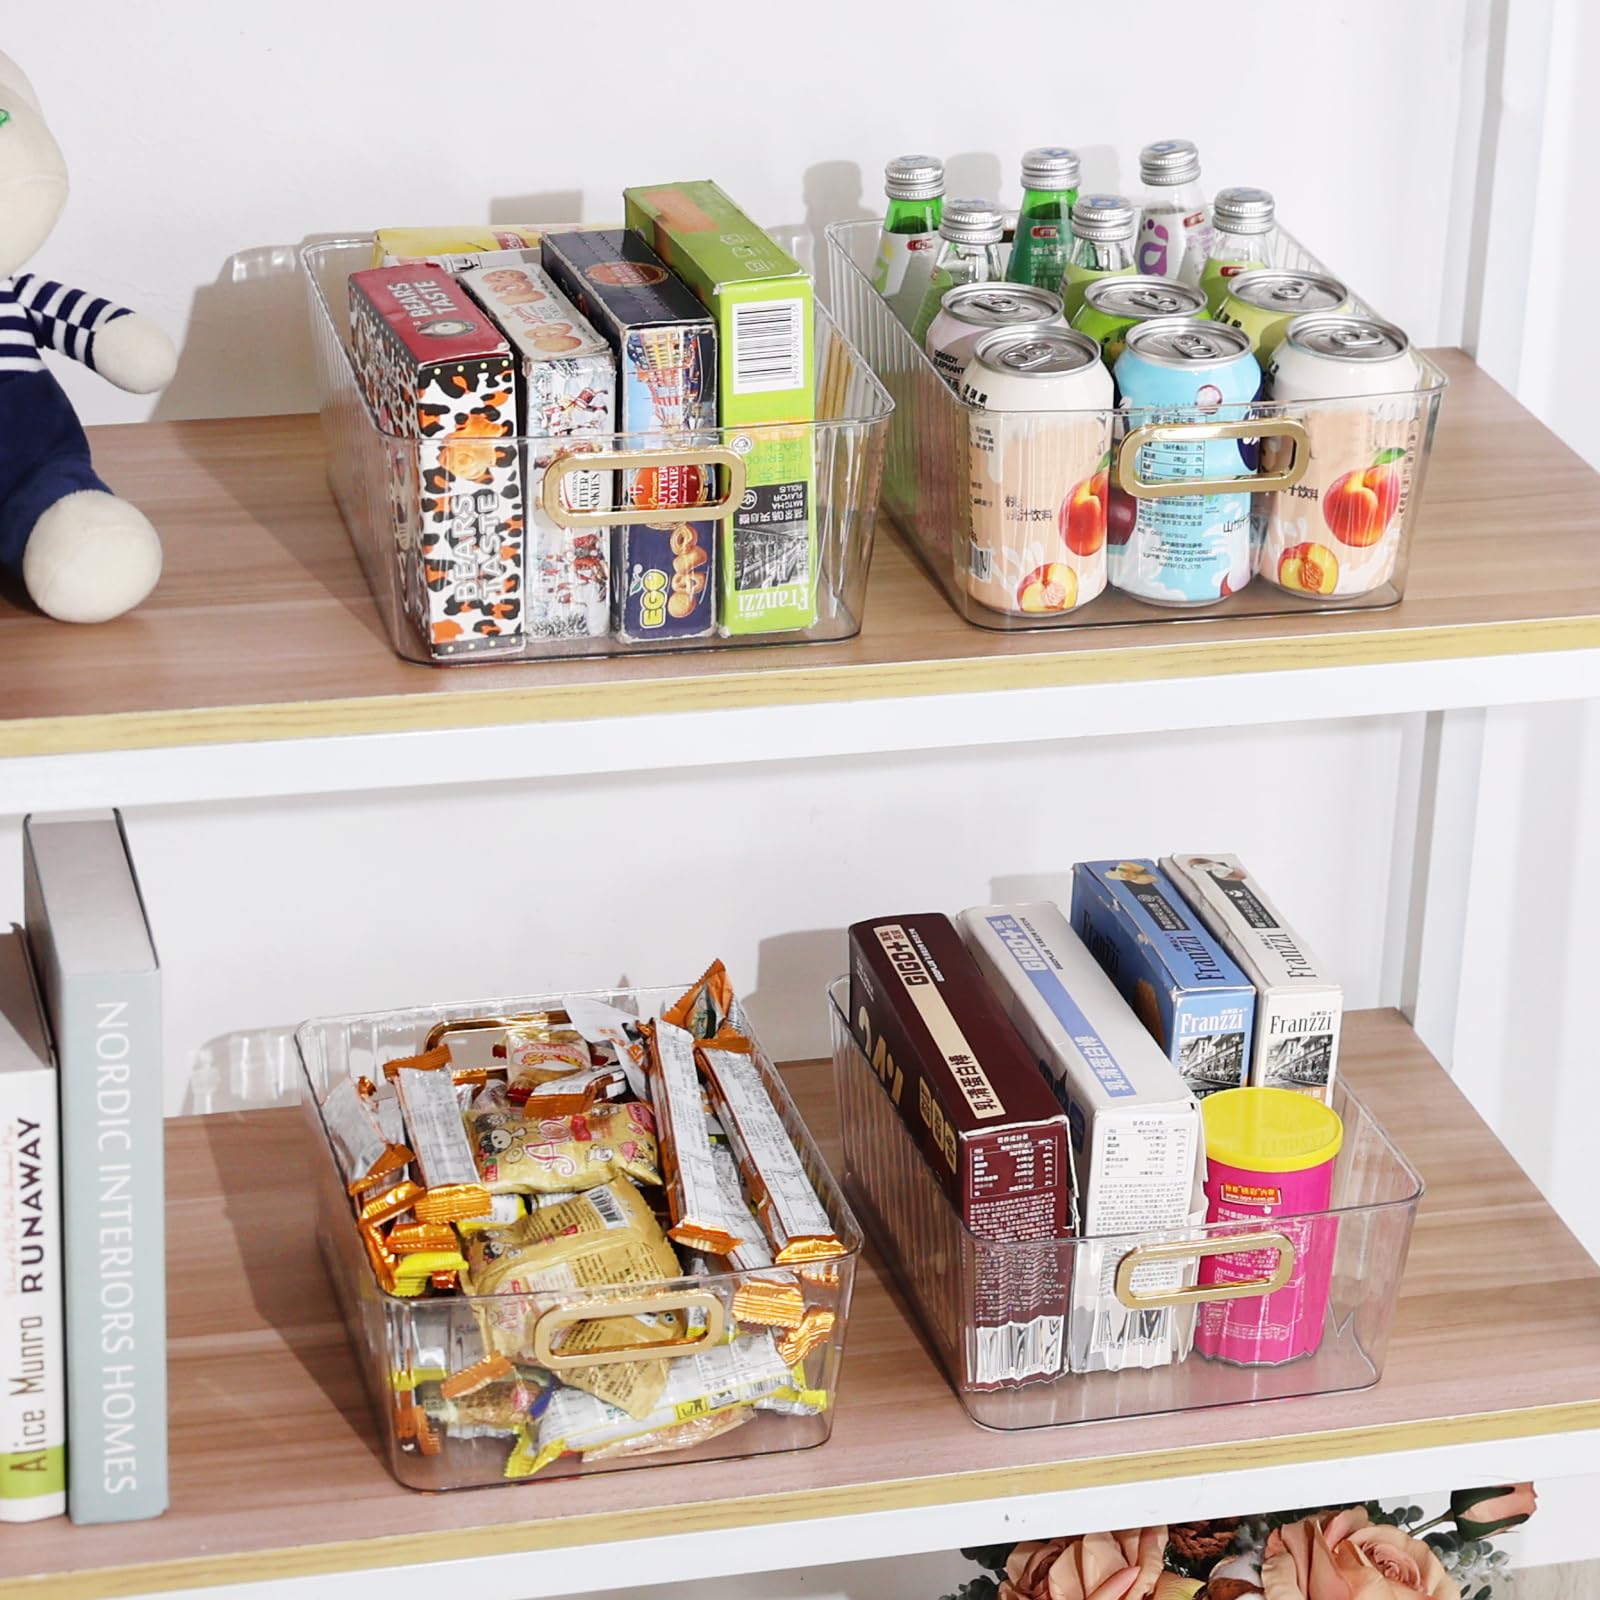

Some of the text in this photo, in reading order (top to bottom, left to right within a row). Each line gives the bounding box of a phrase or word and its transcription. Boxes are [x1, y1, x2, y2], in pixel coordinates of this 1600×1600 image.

[386, 283, 433, 319] BEARS
[413, 279, 459, 315] TASTE
[935, 349, 959, 364] GREEDY
[658, 465, 668, 506] UTTER
[450, 494, 477, 603] BEARS
[477, 493, 500, 599] TASTE
[639, 572, 668, 629] EGO
[737, 583, 810, 612] Franzzi
[1176, 935, 1226, 982] Franzzi
[1266, 933, 1318, 980] Franzzi
[1180, 1012, 1244, 1034] Franzzi
[1269, 1014, 1332, 1035] Franzzi
[949, 1053, 999, 1115] 乳清蛋白棒
[17, 1116, 45, 1294] RUNAWAY
[96, 1001, 137, 1493] NORDIC INTERIORS HOMES
[9, 1317, 48, 1473] Alice Munro
